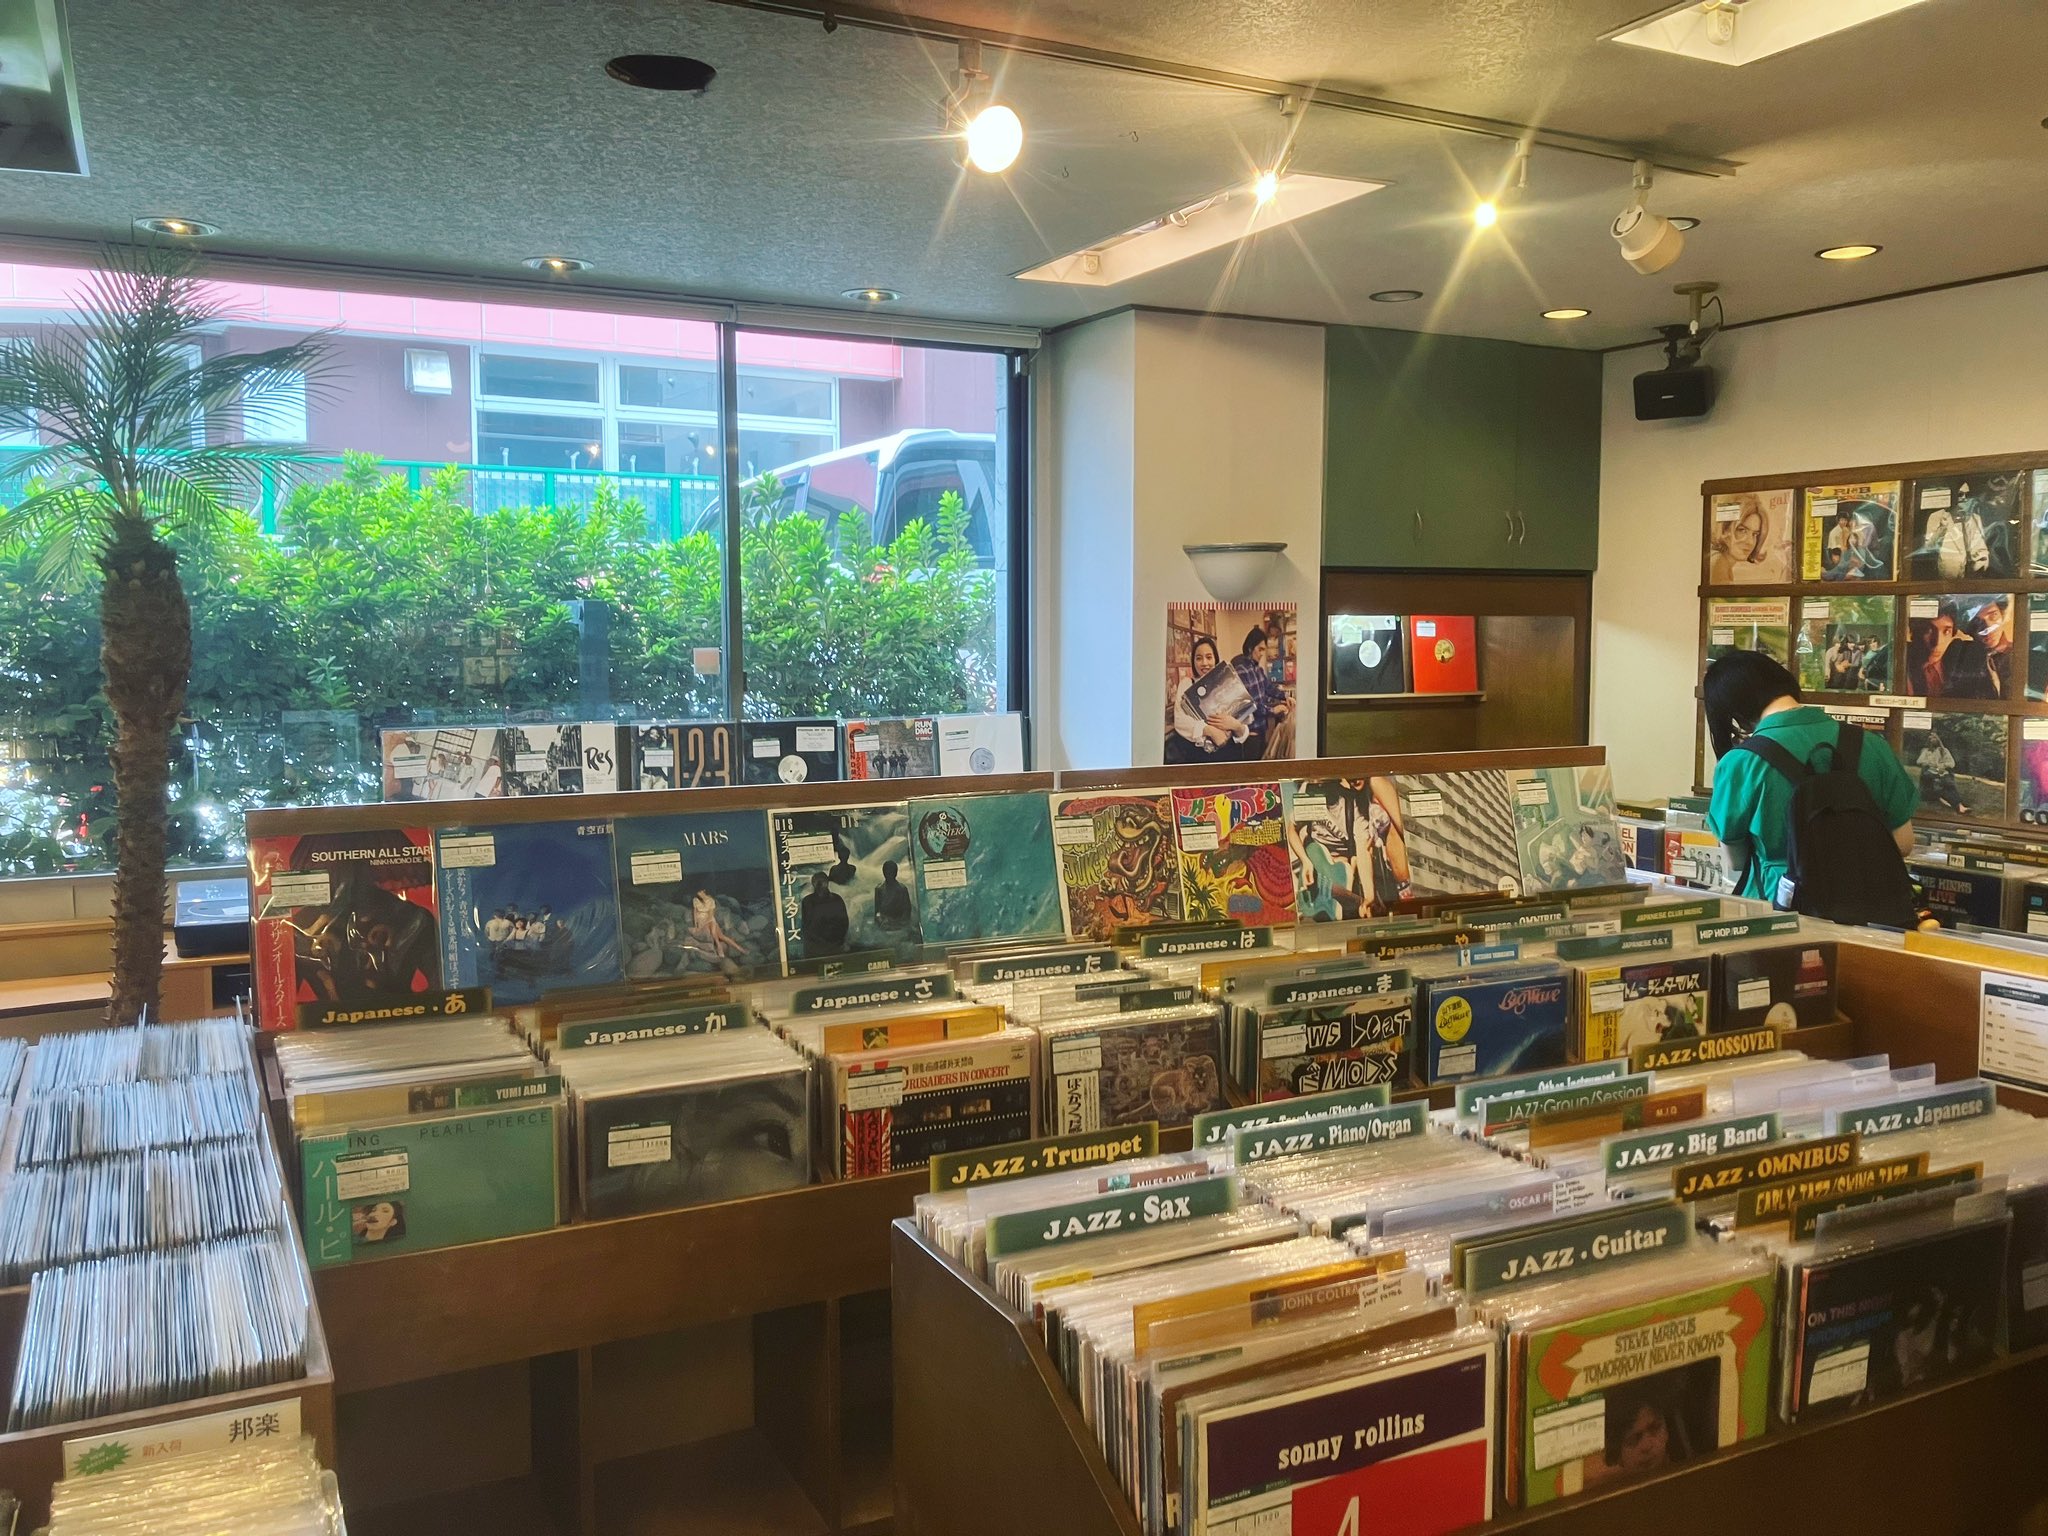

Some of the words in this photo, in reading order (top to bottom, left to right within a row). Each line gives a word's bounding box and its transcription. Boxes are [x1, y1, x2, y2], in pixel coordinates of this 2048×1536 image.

[914, 720, 932, 728] RUN
[914, 728, 933, 736] DMC
[683, 830, 729, 847] MARS
[774, 818, 793, 831] DIS
[311, 849, 376, 863] SOUTHERN
[377, 847, 401, 858] ALL
[402, 846, 432, 857] STAR
[1157, 939, 1228, 955] Japanese
[1239, 930, 1255, 949] は
[1699, 928, 1714, 939] HIP
[867, 960, 890, 972] CAROL
[993, 963, 1072, 981] Japanese
[1085, 954, 1100, 973] た
[810, 989, 899, 1010] Japanese
[914, 979, 934, 999] さ
[1173, 990, 1192, 1001] TULIP
[1286, 984, 1363, 1003] Japanese
[1376, 973, 1393, 994] ま
[322, 1004, 425, 1025] Japanese
[444, 993, 466, 1014] あ
[584, 1024, 687, 1045] Japanese
[705, 1012, 727, 1034] か
[1306, 1022, 1341, 1050] WS
[1644, 1047, 1692, 1069] JAZZ
[1698, 1030, 1775, 1060] CROSSOVER
[959, 1070, 970, 1083] IN
[970, 1064, 1011, 1082] CONCERT
[495, 1086, 522, 1100] YUMI
[523, 1083, 547, 1098] ARAI
[348, 1134, 381, 1148] ING
[419, 1123, 475, 1139] PEARL
[485, 1111, 549, 1129] PIERCE
[1850, 1112, 1903, 1136] JAZZ
[1913, 1098, 1984, 1127] Japanese
[1249, 1132, 1314, 1159] JAZZ
[1328, 1116, 1412, 1145] Piano/Organ
[1615, 1142, 1674, 1169] JAZZ
[1687, 1131, 1718, 1156] Big
[1723, 1121, 1768, 1148] Band
[951, 1155, 1025, 1185] JAZZ
[1042, 1134, 1143, 1168] Trumpet
[1683, 1166, 1744, 1195] JAZZ
[1757, 1141, 1850, 1178] OMNIBUS
[1509, 1193, 1541, 1209] OSCAR
[1755, 1184, 1796, 1216] EARLY
[1043, 1208, 1122, 1241] JAZZ
[1143, 1194, 1191, 1224] Sax
[1501, 1246, 1575, 1281] JAZZ
[1591, 1227, 1668, 1260] Guitar
[1281, 1292, 1313, 1311] JOHN
[1315, 1283, 1361, 1305] COLTRA
[1615, 1328, 1650, 1354] STEVE
[1651, 1316, 1697, 1347] MARCUS
[1807, 1312, 1827, 1328] ON
[1583, 1350, 1648, 1385] TOMORROW
[1649, 1342, 1687, 1368] NEVER
[1686, 1331, 1726, 1356] KNOWS
[227, 1412, 281, 1444] 邦楽
[1277, 1434, 1344, 1471] sonny
[1354, 1413, 1426, 1450] rollins
